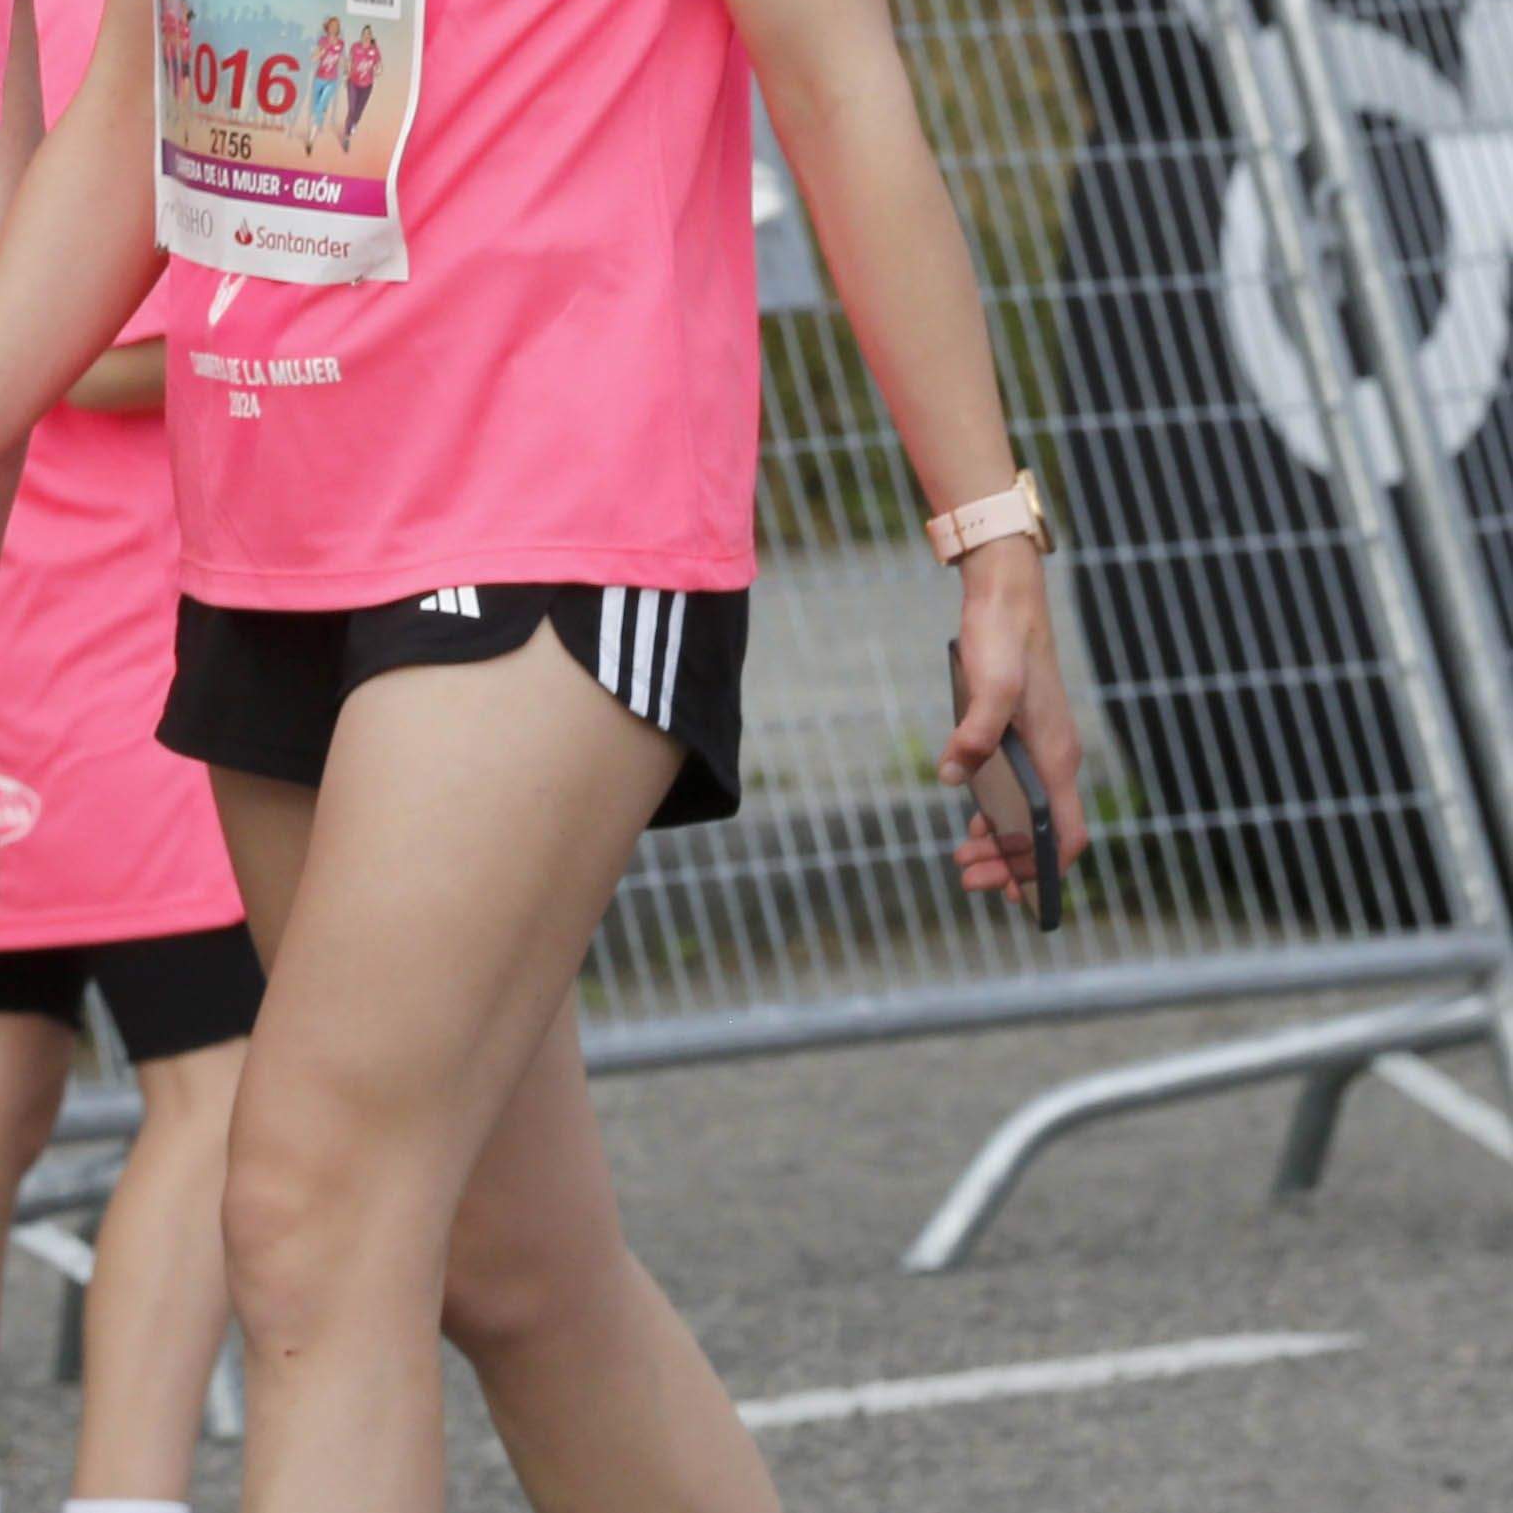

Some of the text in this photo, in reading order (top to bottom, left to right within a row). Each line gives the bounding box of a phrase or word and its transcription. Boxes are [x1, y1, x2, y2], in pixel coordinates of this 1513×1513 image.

[193, 42, 302, 117] 016
[209, 126, 253, 161] 2756
[231, 169, 282, 197] MUJER
[292, 175, 343, 205] GIJÓN
[256, 225, 352, 259] Santander
[242, 359, 269, 386] LA
[267, 356, 342, 387] MUJER
